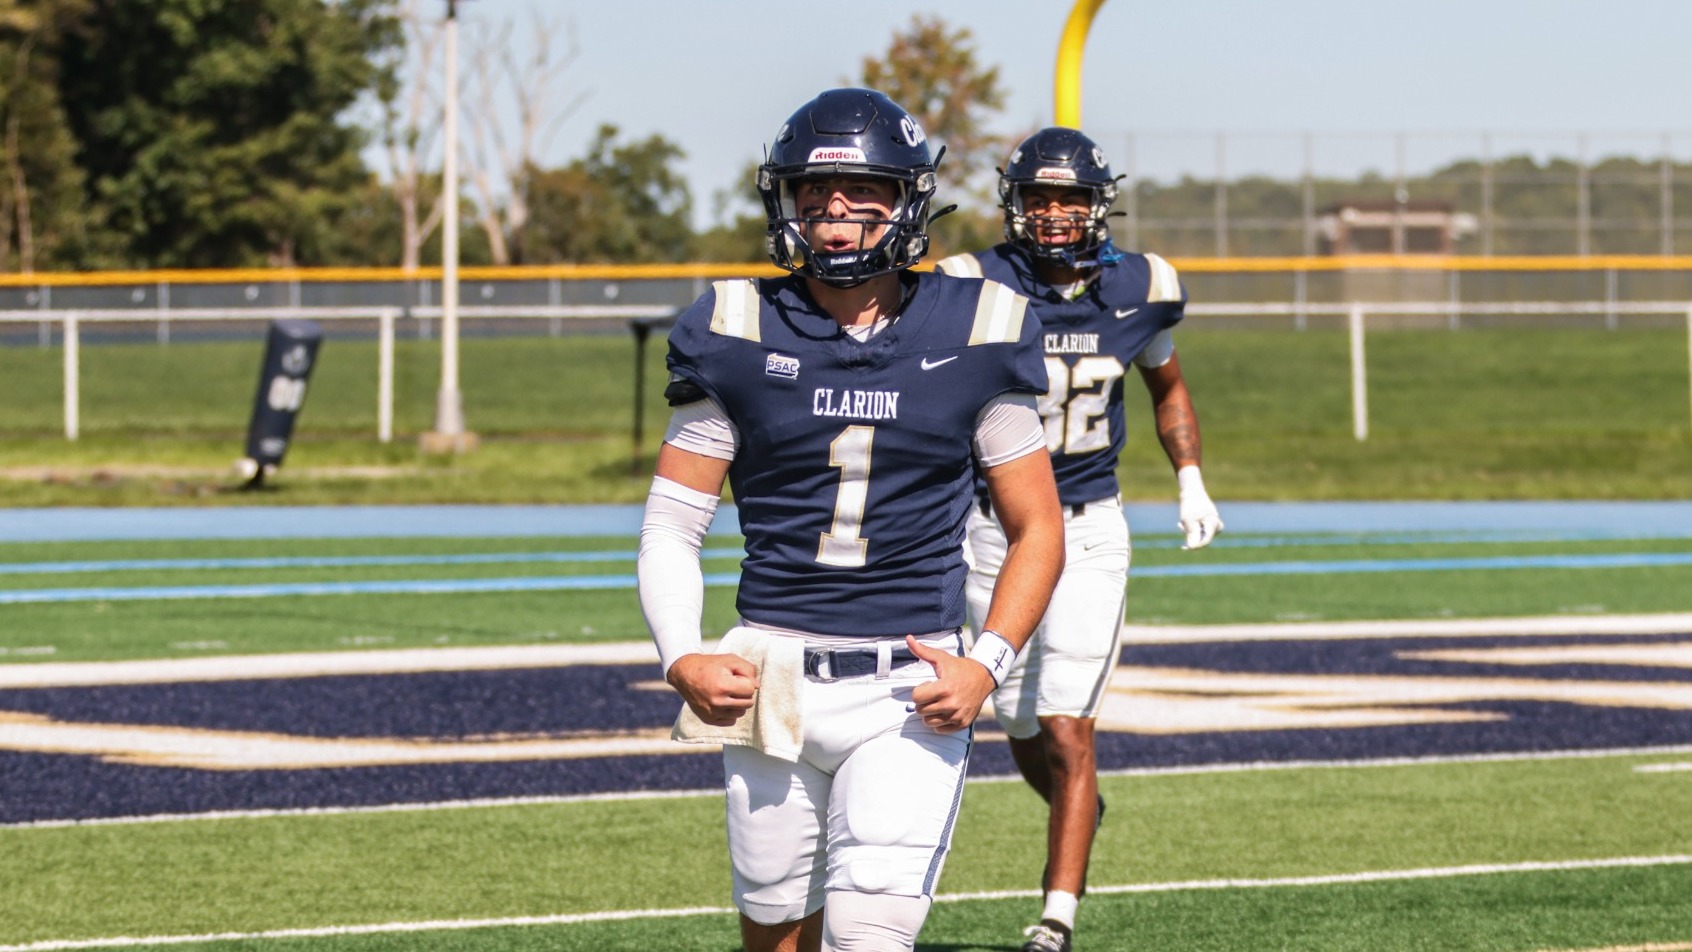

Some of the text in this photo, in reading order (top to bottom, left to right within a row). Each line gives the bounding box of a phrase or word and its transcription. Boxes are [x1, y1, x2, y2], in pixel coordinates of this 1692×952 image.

[1044, 333, 1099, 353] CLARION
[767, 360, 798, 373] PSAC
[812, 388, 899, 419] CLARION
[815, 425, 875, 567] 1
